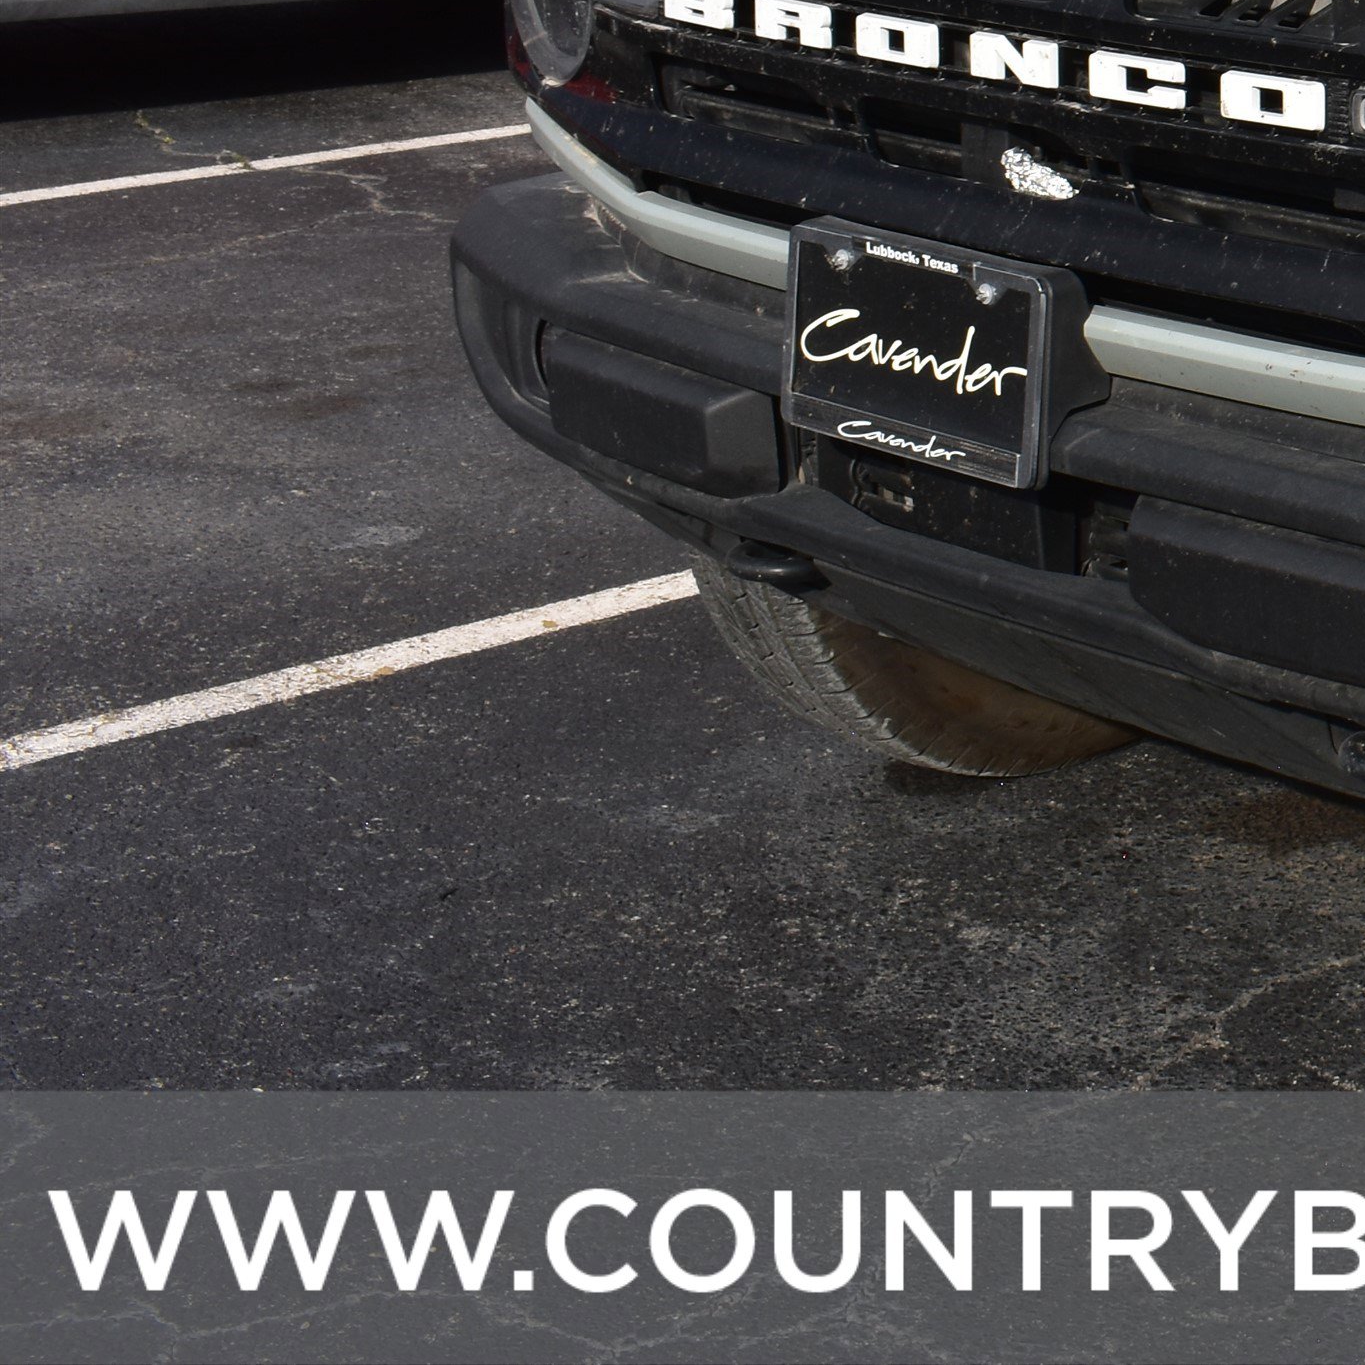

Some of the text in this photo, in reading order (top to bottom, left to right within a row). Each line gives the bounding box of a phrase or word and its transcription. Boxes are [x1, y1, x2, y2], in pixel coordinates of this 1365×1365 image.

[865, 241, 959, 275] Lubbock, Texas
[801, 308, 1028, 396] Cavender
[837, 420, 966, 461] Cavender
